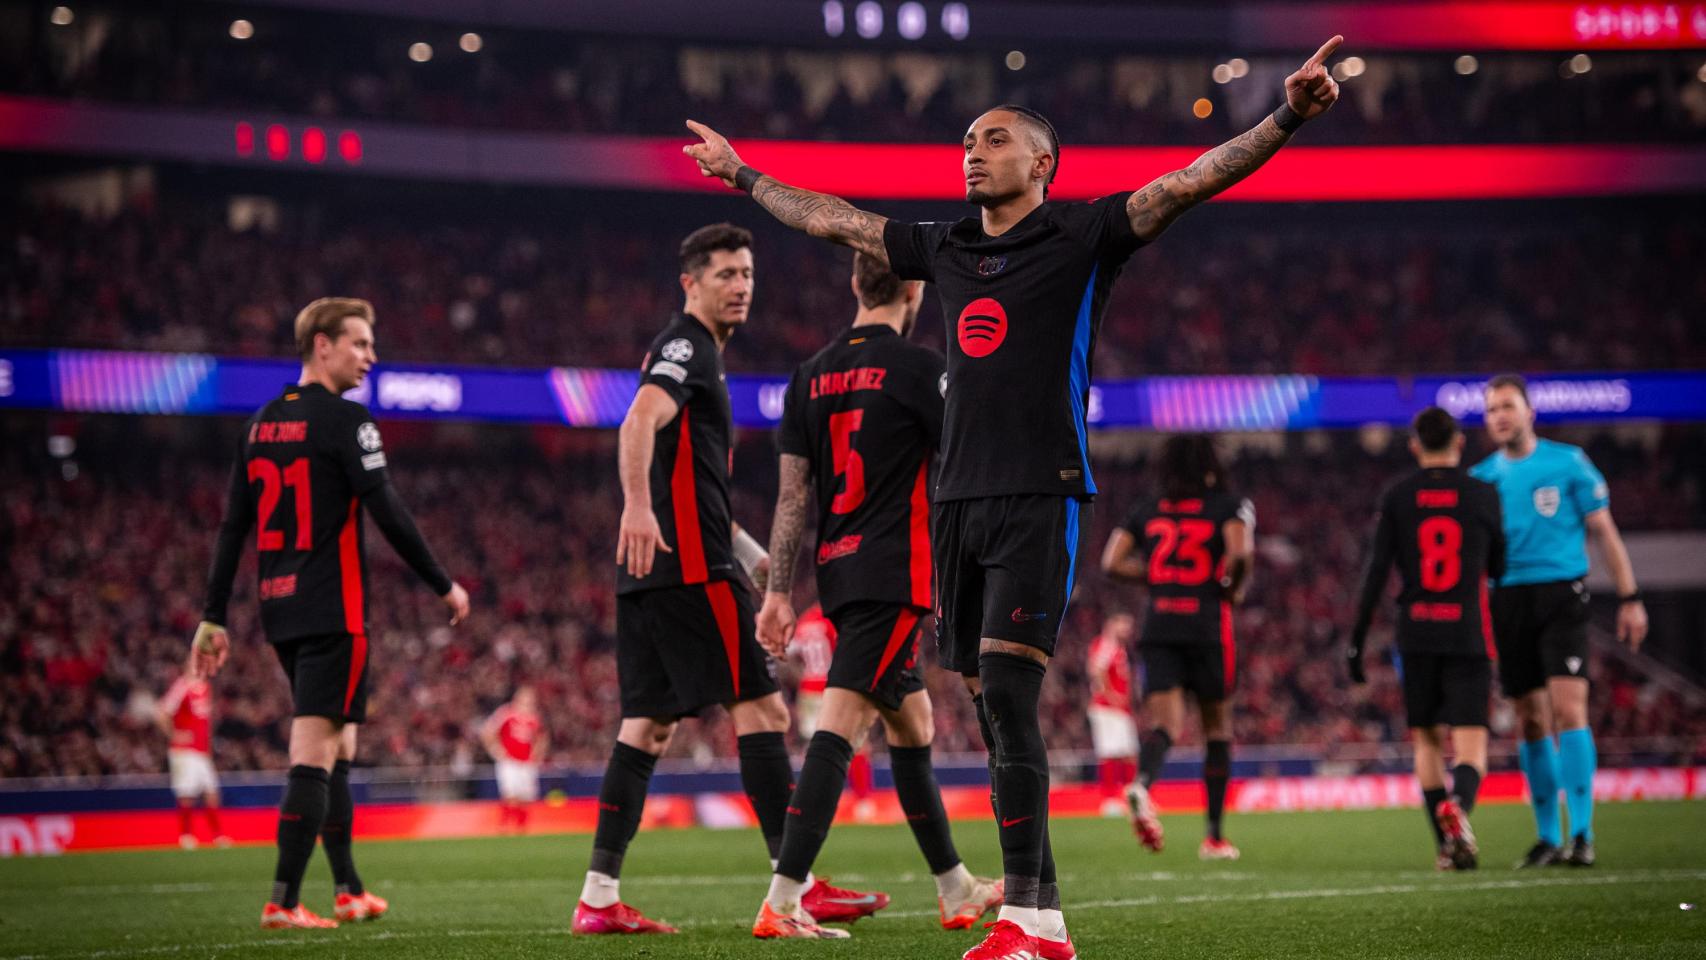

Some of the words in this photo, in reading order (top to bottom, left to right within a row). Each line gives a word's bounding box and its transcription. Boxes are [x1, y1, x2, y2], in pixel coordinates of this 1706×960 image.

[247, 456, 312, 551] 21
[829, 408, 865, 515] 5
[1145, 517, 1214, 586] 23
[1418, 516, 1462, 592] 8
